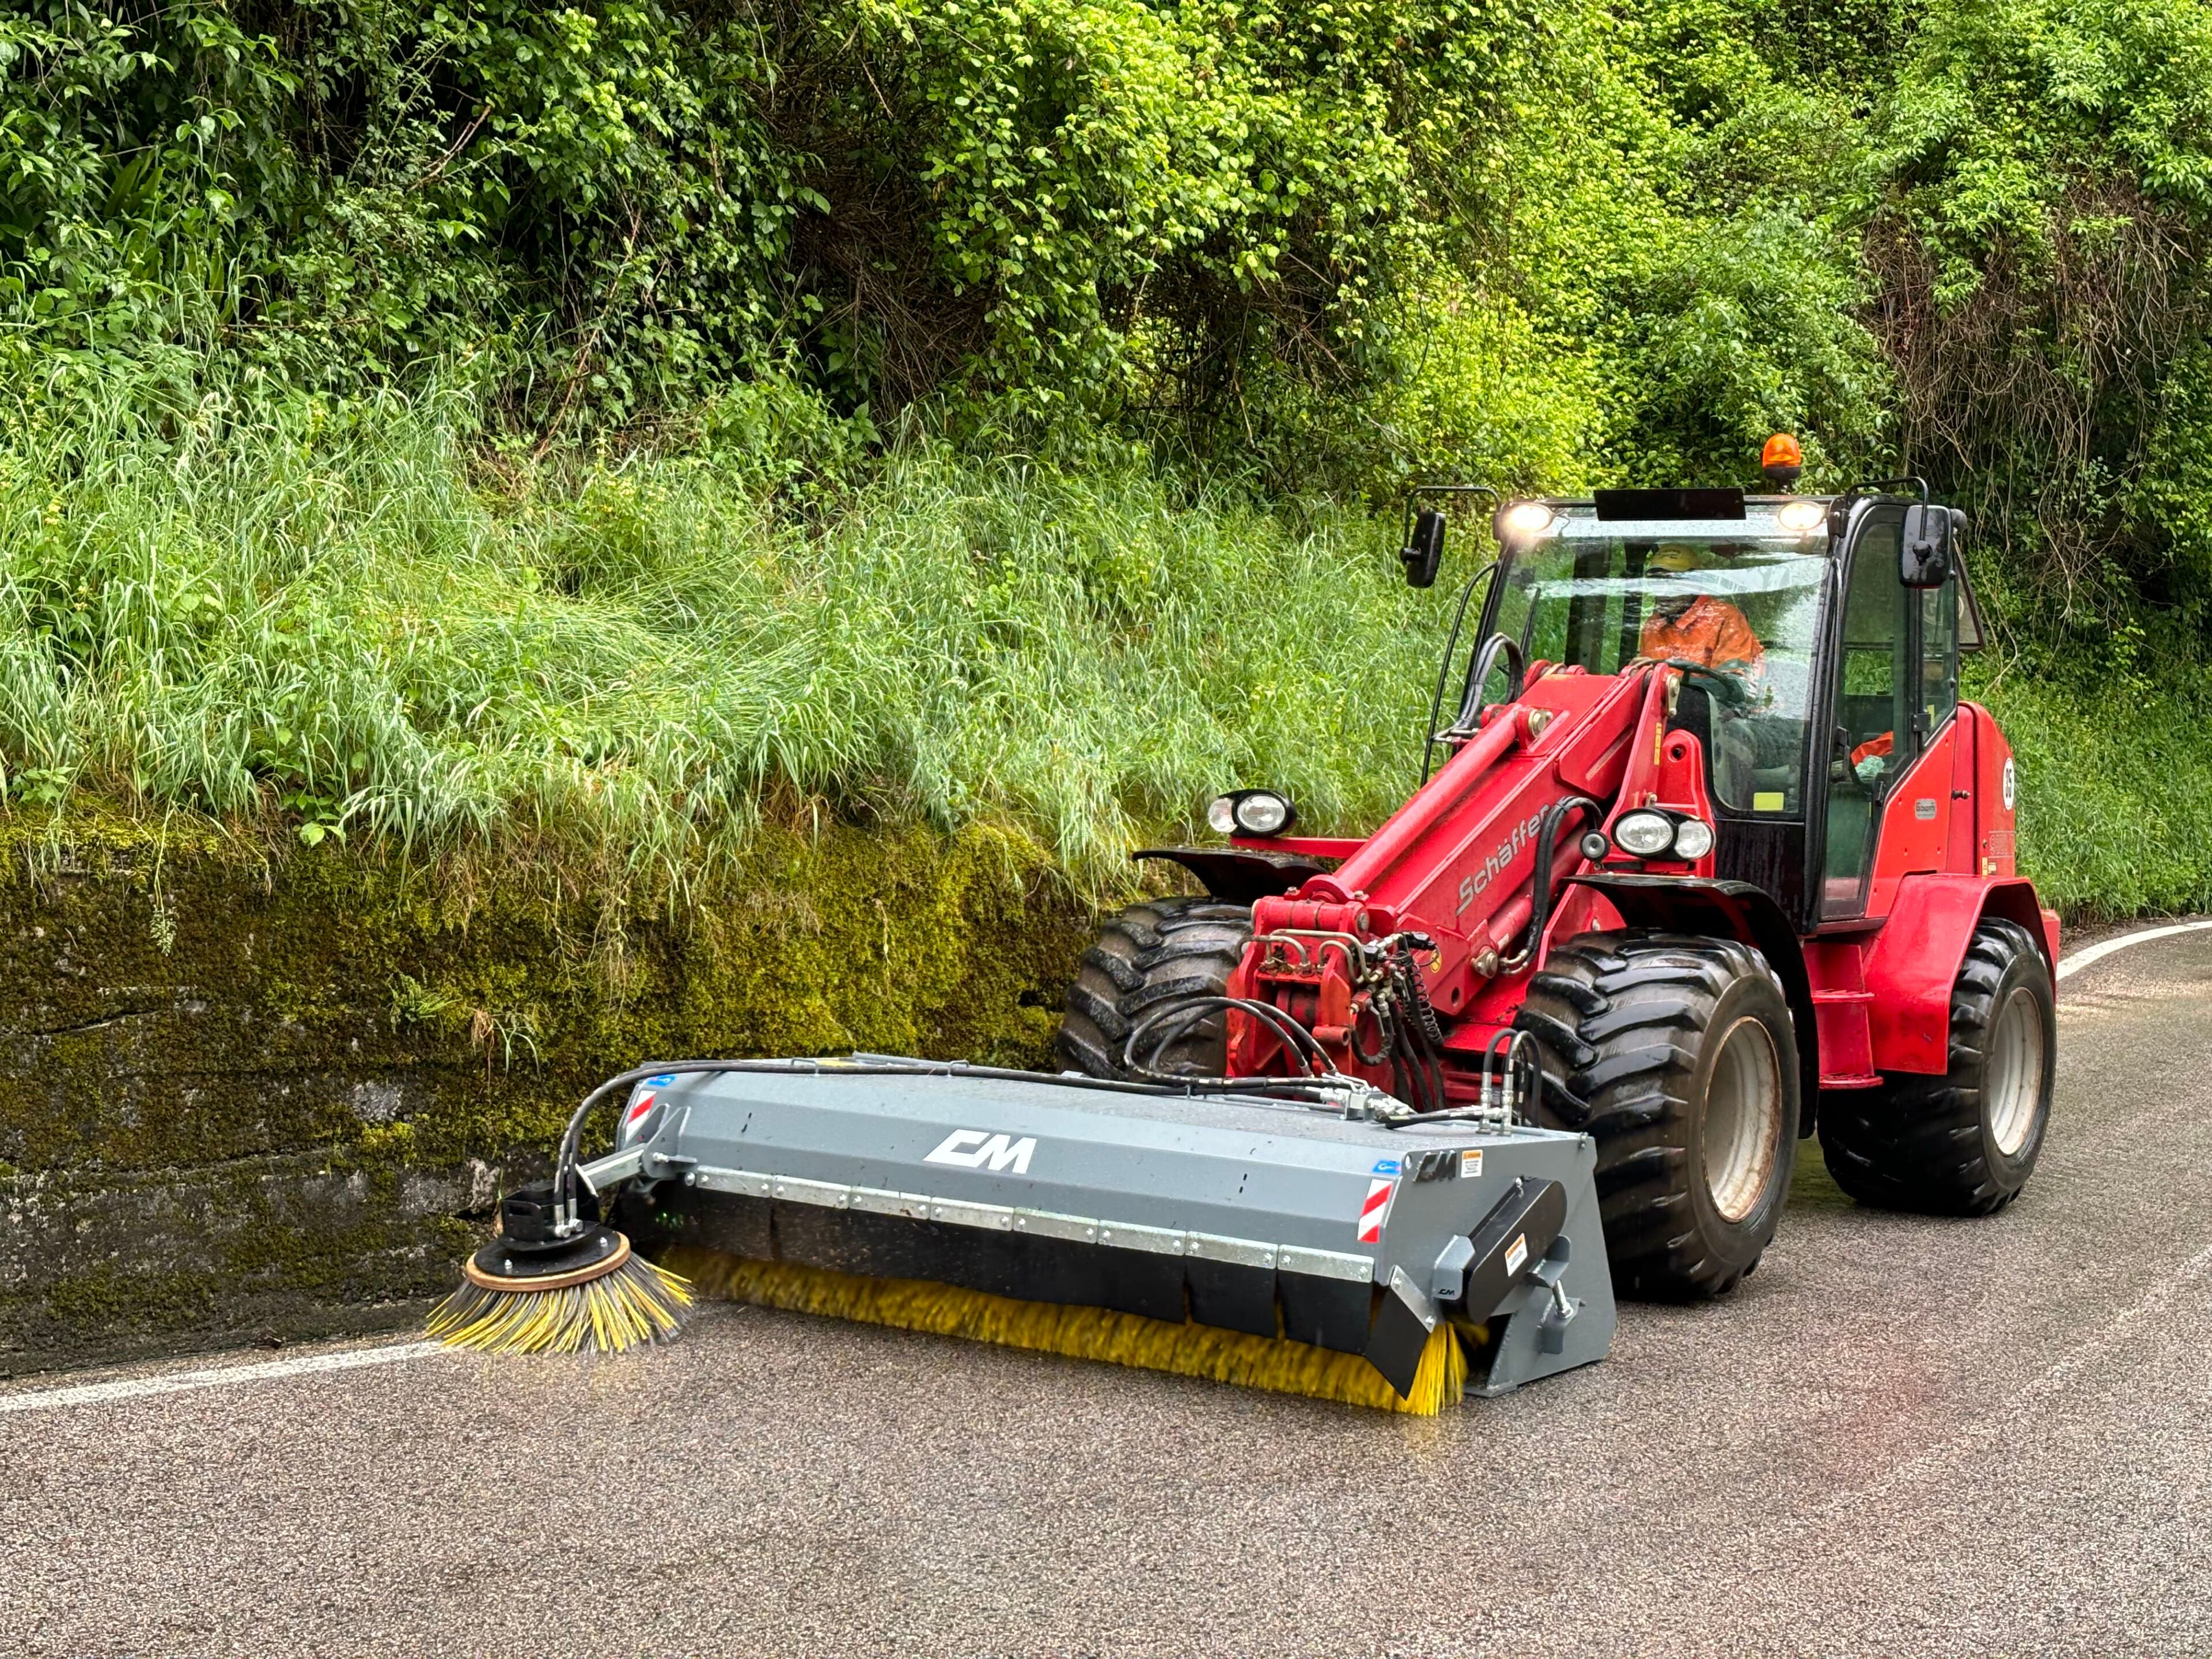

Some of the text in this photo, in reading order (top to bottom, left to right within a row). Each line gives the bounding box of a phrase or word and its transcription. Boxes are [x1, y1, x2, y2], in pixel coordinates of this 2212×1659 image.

[2005, 767, 2012, 798] 35
[1456, 804, 1550, 916] Schäffer
[923, 1129, 1037, 1174] CM
[1413, 1152, 1457, 1182] CM
